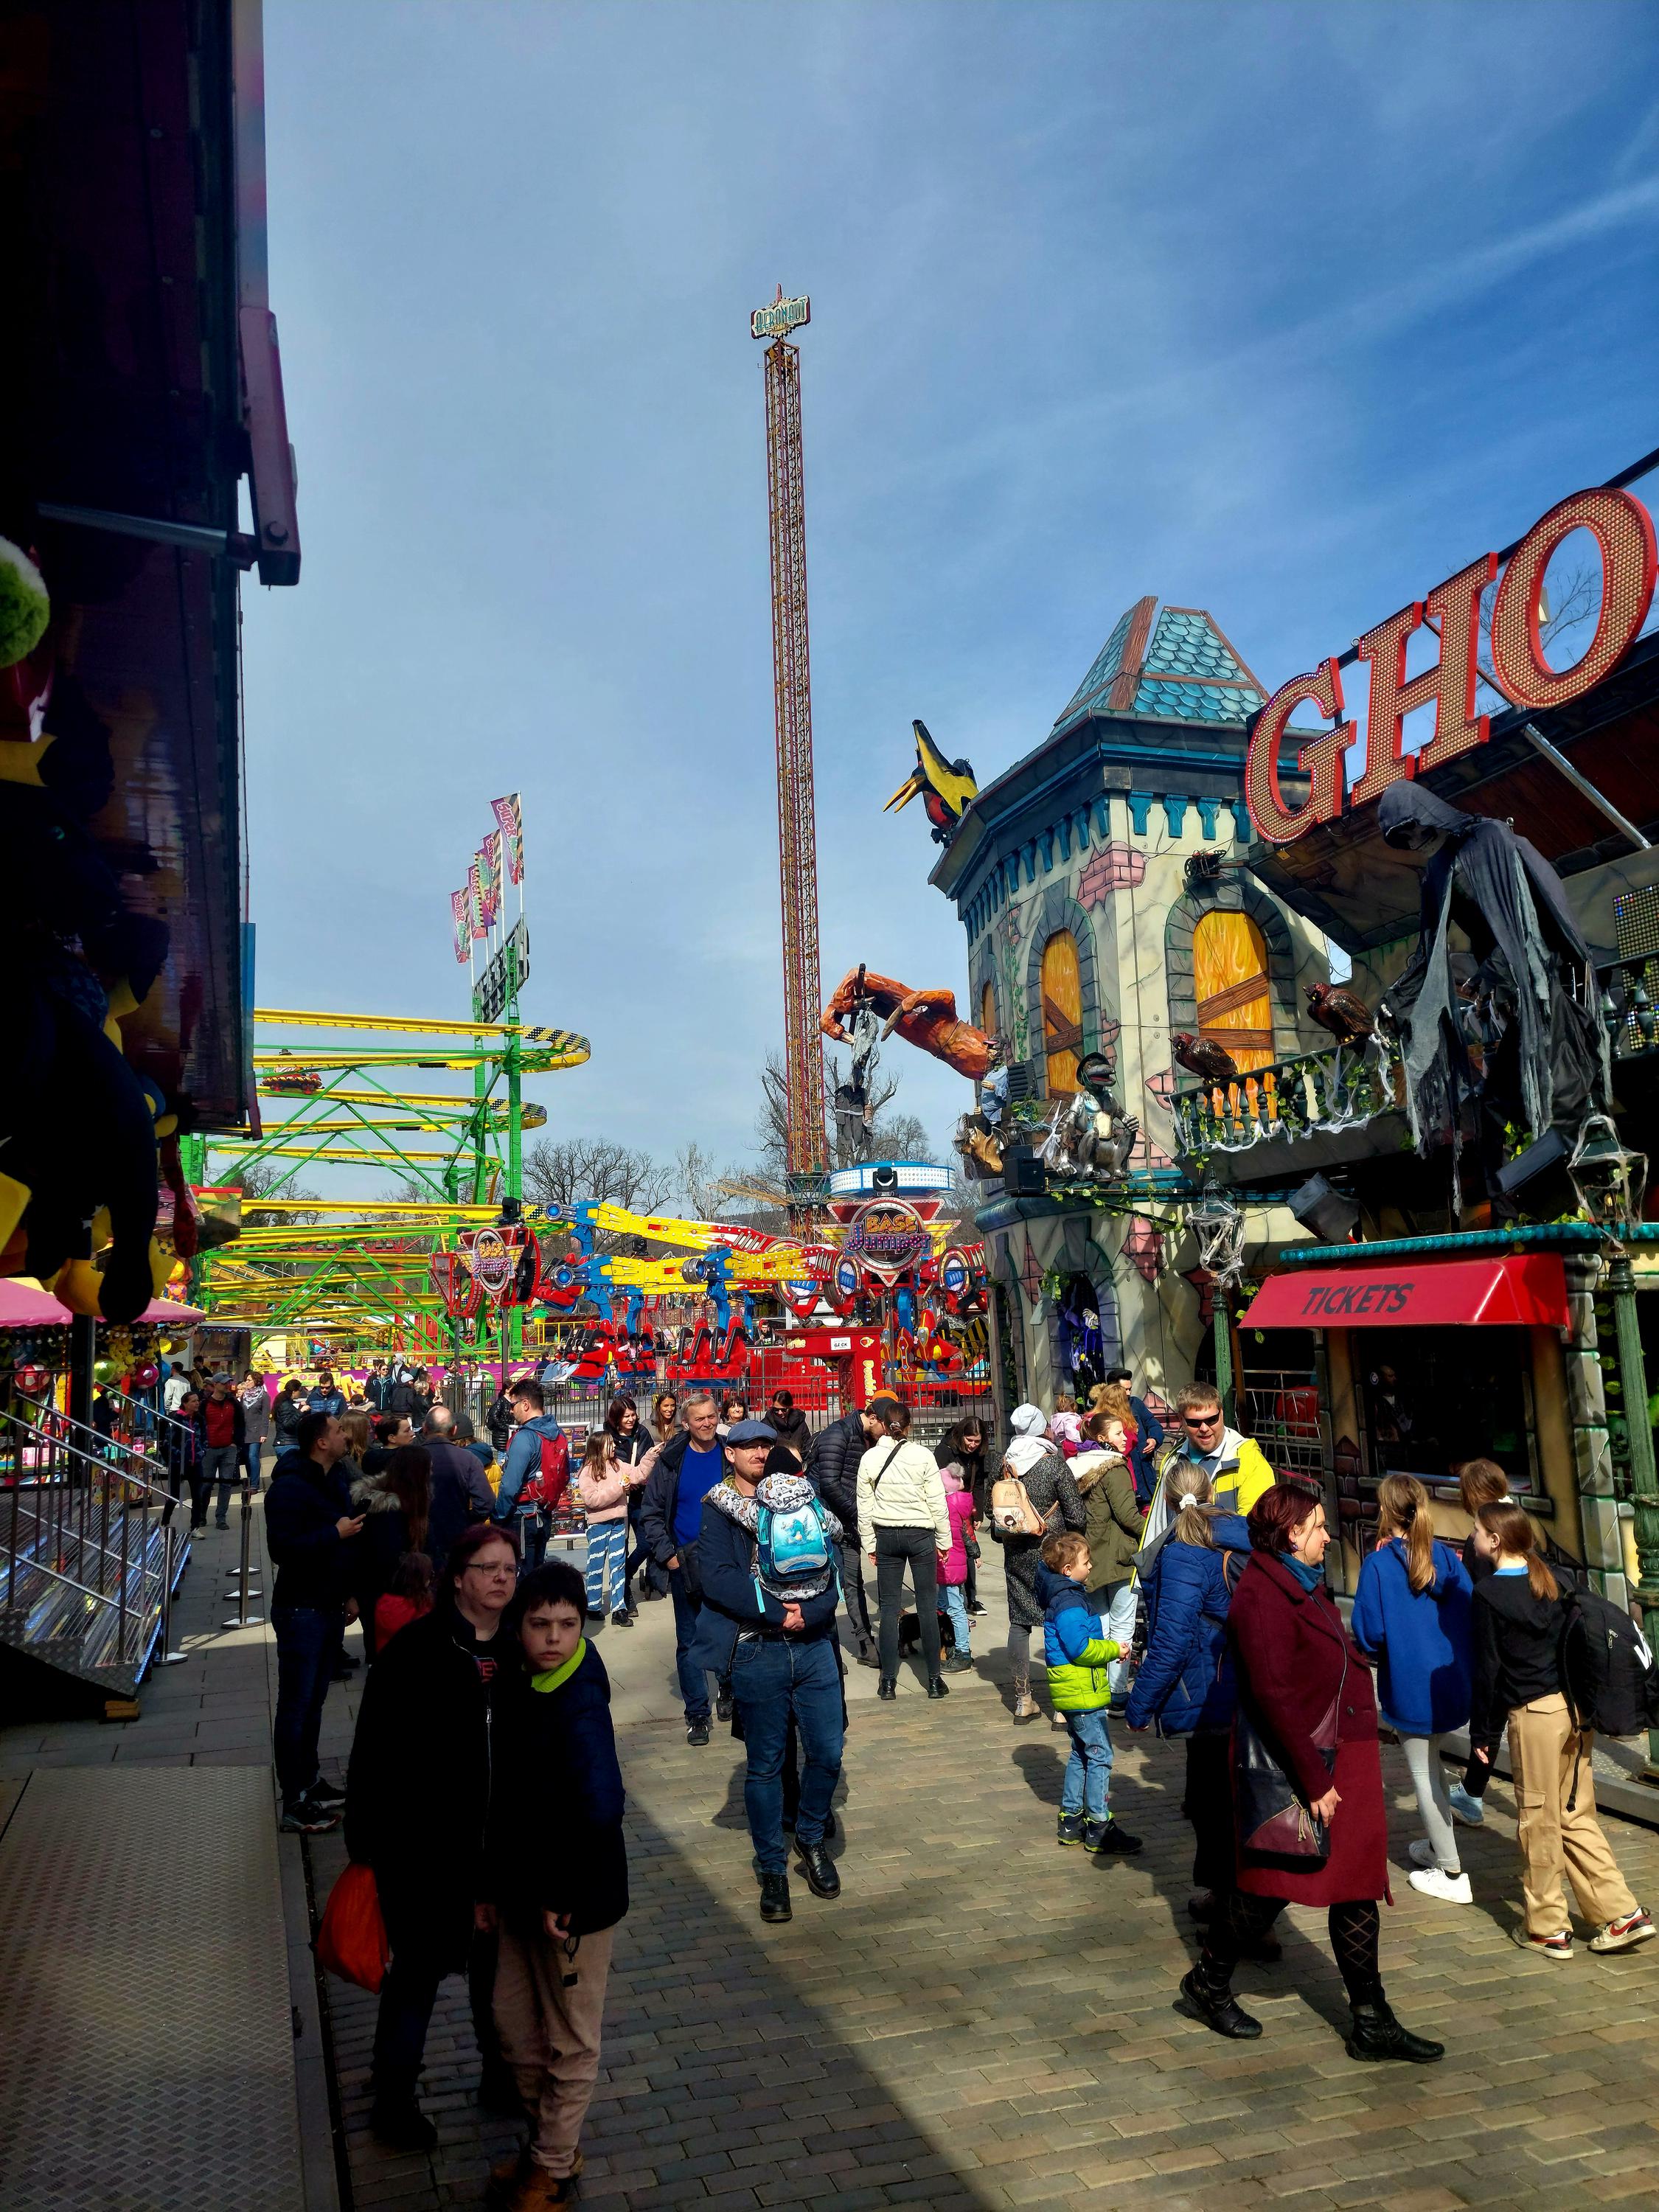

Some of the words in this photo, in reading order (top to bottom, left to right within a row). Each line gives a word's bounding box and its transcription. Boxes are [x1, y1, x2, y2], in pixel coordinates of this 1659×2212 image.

[754, 299, 807, 334] AERONAUT
[496, 802, 518, 837] SUPER
[486, 837, 495, 868] SUPER
[453, 894, 466, 922] SUPER
[844, 1222, 931, 1254] Jumper
[866, 1213, 917, 1234] BASE
[479, 1240, 505, 1259] BASE
[1301, 1283, 1415, 1315] TICKETS
